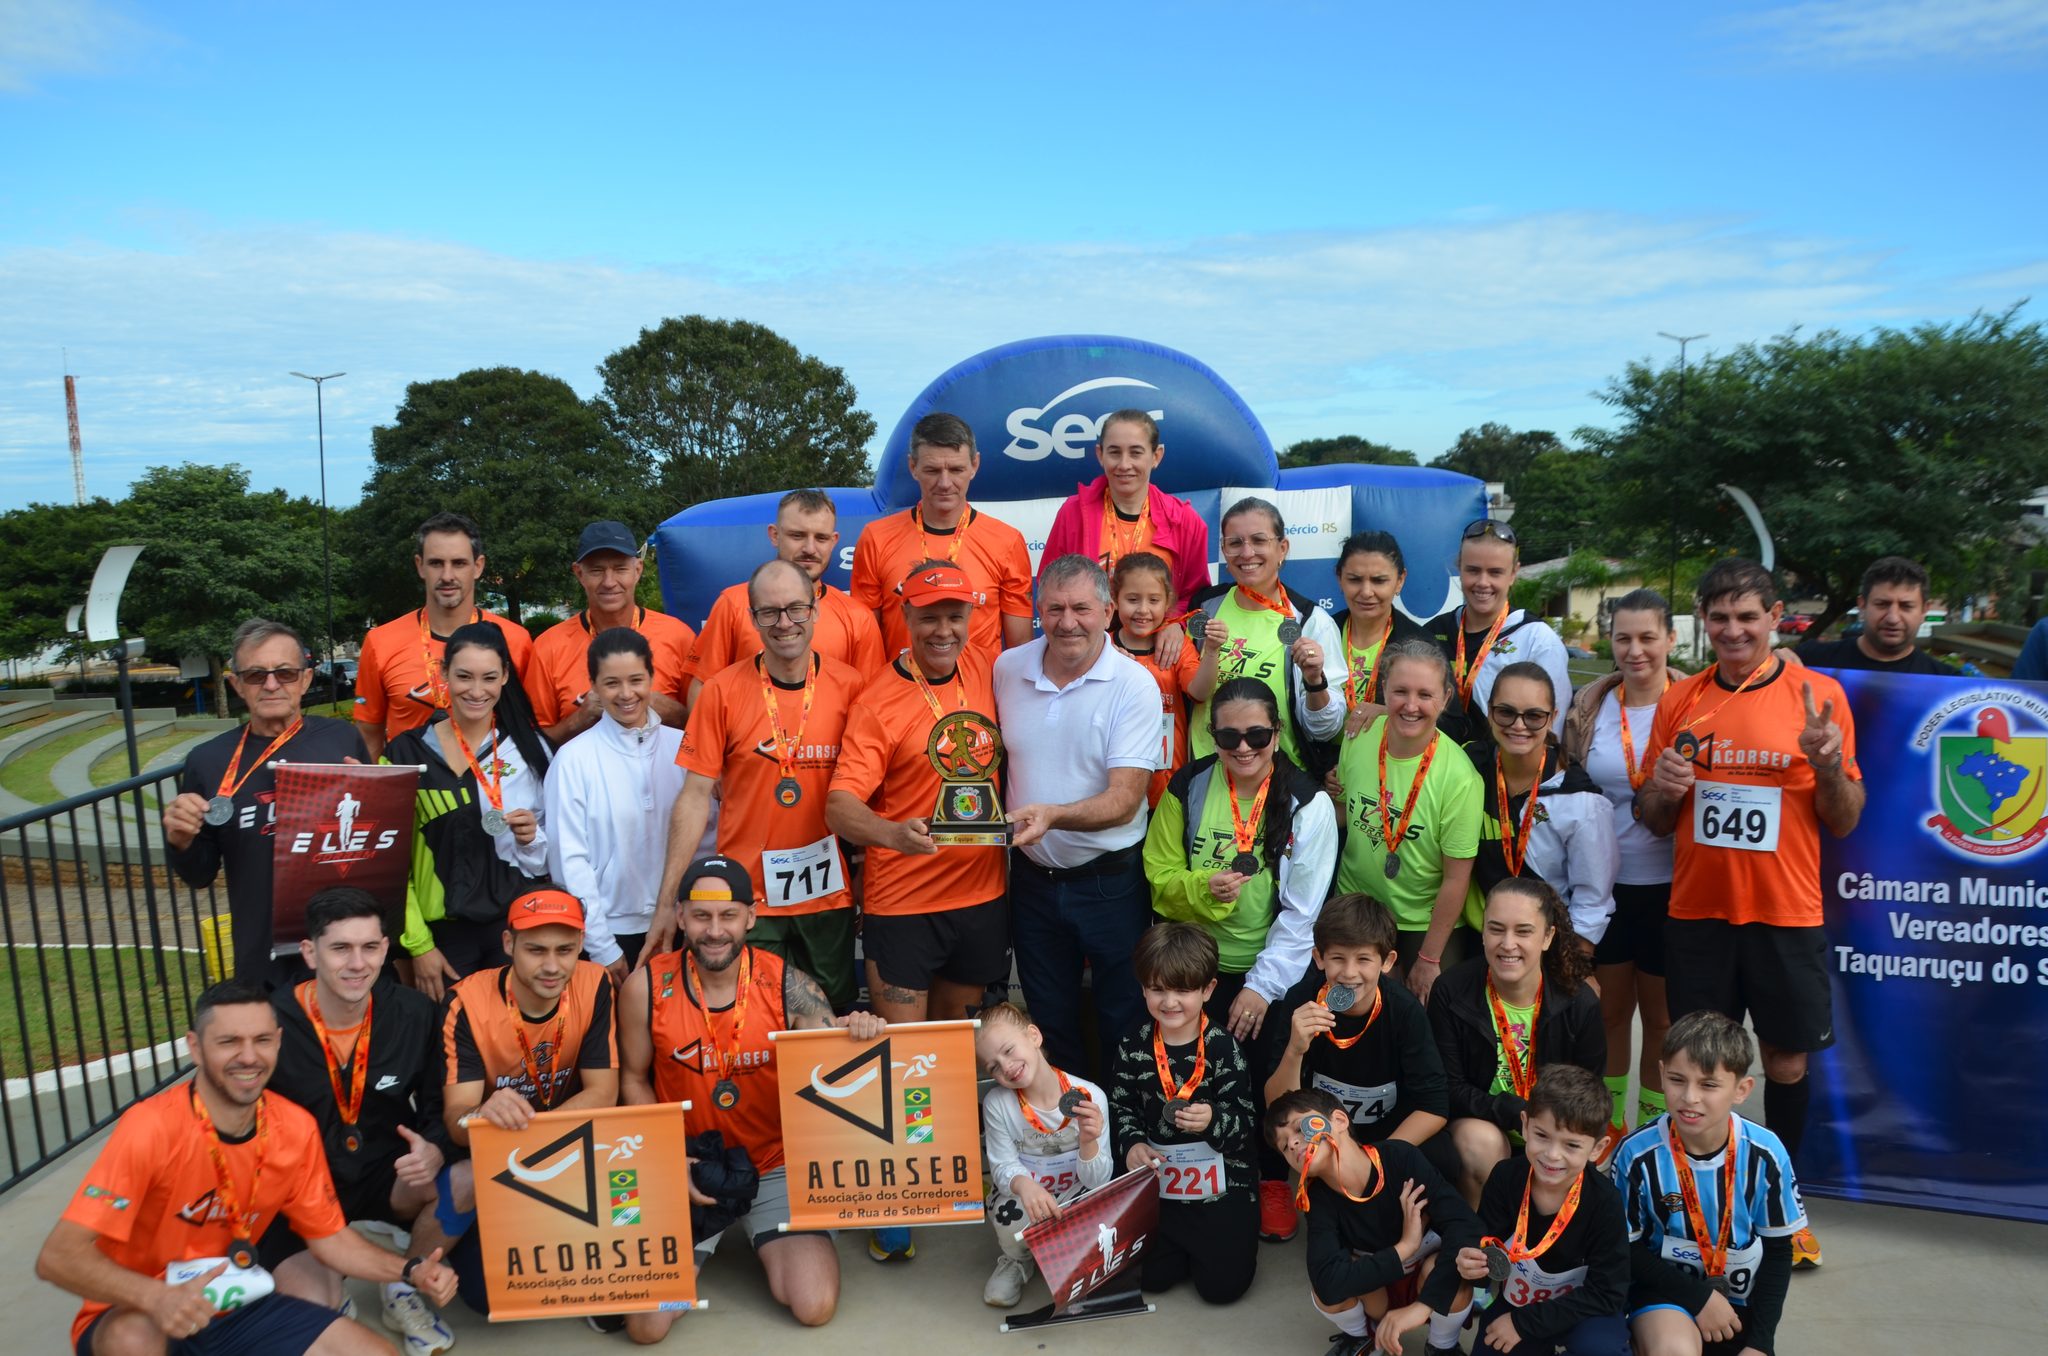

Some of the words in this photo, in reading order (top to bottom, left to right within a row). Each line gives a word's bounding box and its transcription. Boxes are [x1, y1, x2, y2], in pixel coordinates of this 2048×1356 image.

[1003, 407, 1164, 461] Se
[1322, 522, 1338, 533] RS
[1916, 712, 1945, 748] PODER
[1944, 692, 2021, 714] LEGISLATIVO
[1713, 749, 1792, 768] ACORSEB
[1702, 805, 1767, 844] 649
[291, 830, 399, 853] ELES
[776, 859, 831, 900] 717
[1837, 872, 1950, 903] Câmara
[1888, 912, 2048, 947] Vereadores
[1834, 946, 1983, 987] Taquaruçu
[1992, 956, 2029, 985] do
[1343, 1099, 1385, 1121] 74
[808, 1155, 968, 1189] ACORSEB
[808, 1191, 872, 1204] Associação
[876, 1190, 898, 1200] dos
[901, 1188, 969, 1200] Corredores
[839, 1209, 854, 1219] de
[858, 1207, 880, 1218] Rua
[883, 1206, 898, 1217] de
[902, 1204, 940, 1216] Seberi
[508, 1236, 678, 1276] ACORSEB
[1067, 1233, 1146, 1302] ELES
[507, 1277, 576, 1290] Associação
[581, 1273, 604, 1285] dos
[608, 1270, 680, 1284] Corredores
[541, 1296, 556, 1305] de
[561, 1294, 585, 1304] Rua
[589, 1293, 604, 1302] de
[609, 1289, 650, 1300] Seberi
